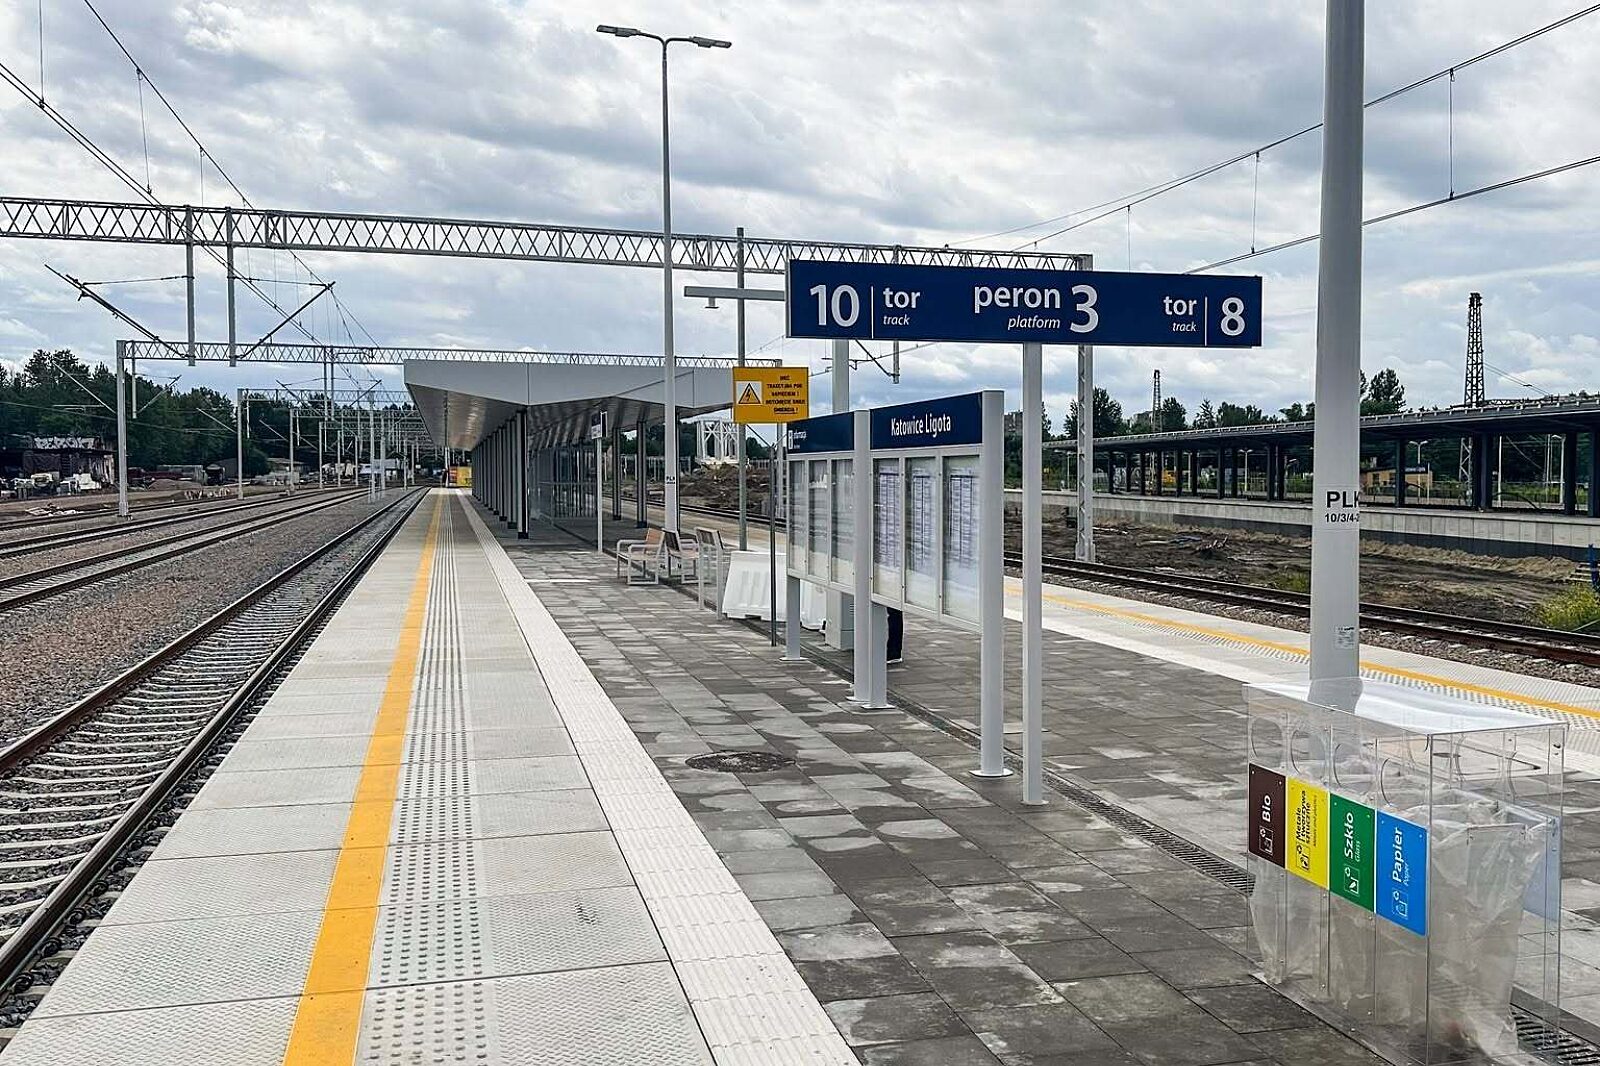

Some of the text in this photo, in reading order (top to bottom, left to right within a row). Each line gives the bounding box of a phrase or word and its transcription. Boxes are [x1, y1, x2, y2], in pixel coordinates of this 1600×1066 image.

[809, 284, 921, 328] 10 tor
[883, 313, 910, 326] track
[974, 284, 1099, 334] peron 3
[1008, 315, 1061, 331] platform
[1164, 295, 1245, 336] tor 8
[1172, 321, 1197, 333] track
[891, 413, 951, 438] Katowice Ligota
[1262, 795, 1271, 823] Bio
[1344, 811, 1354, 860] Szkło
[1392, 827, 1404, 883] Papier
